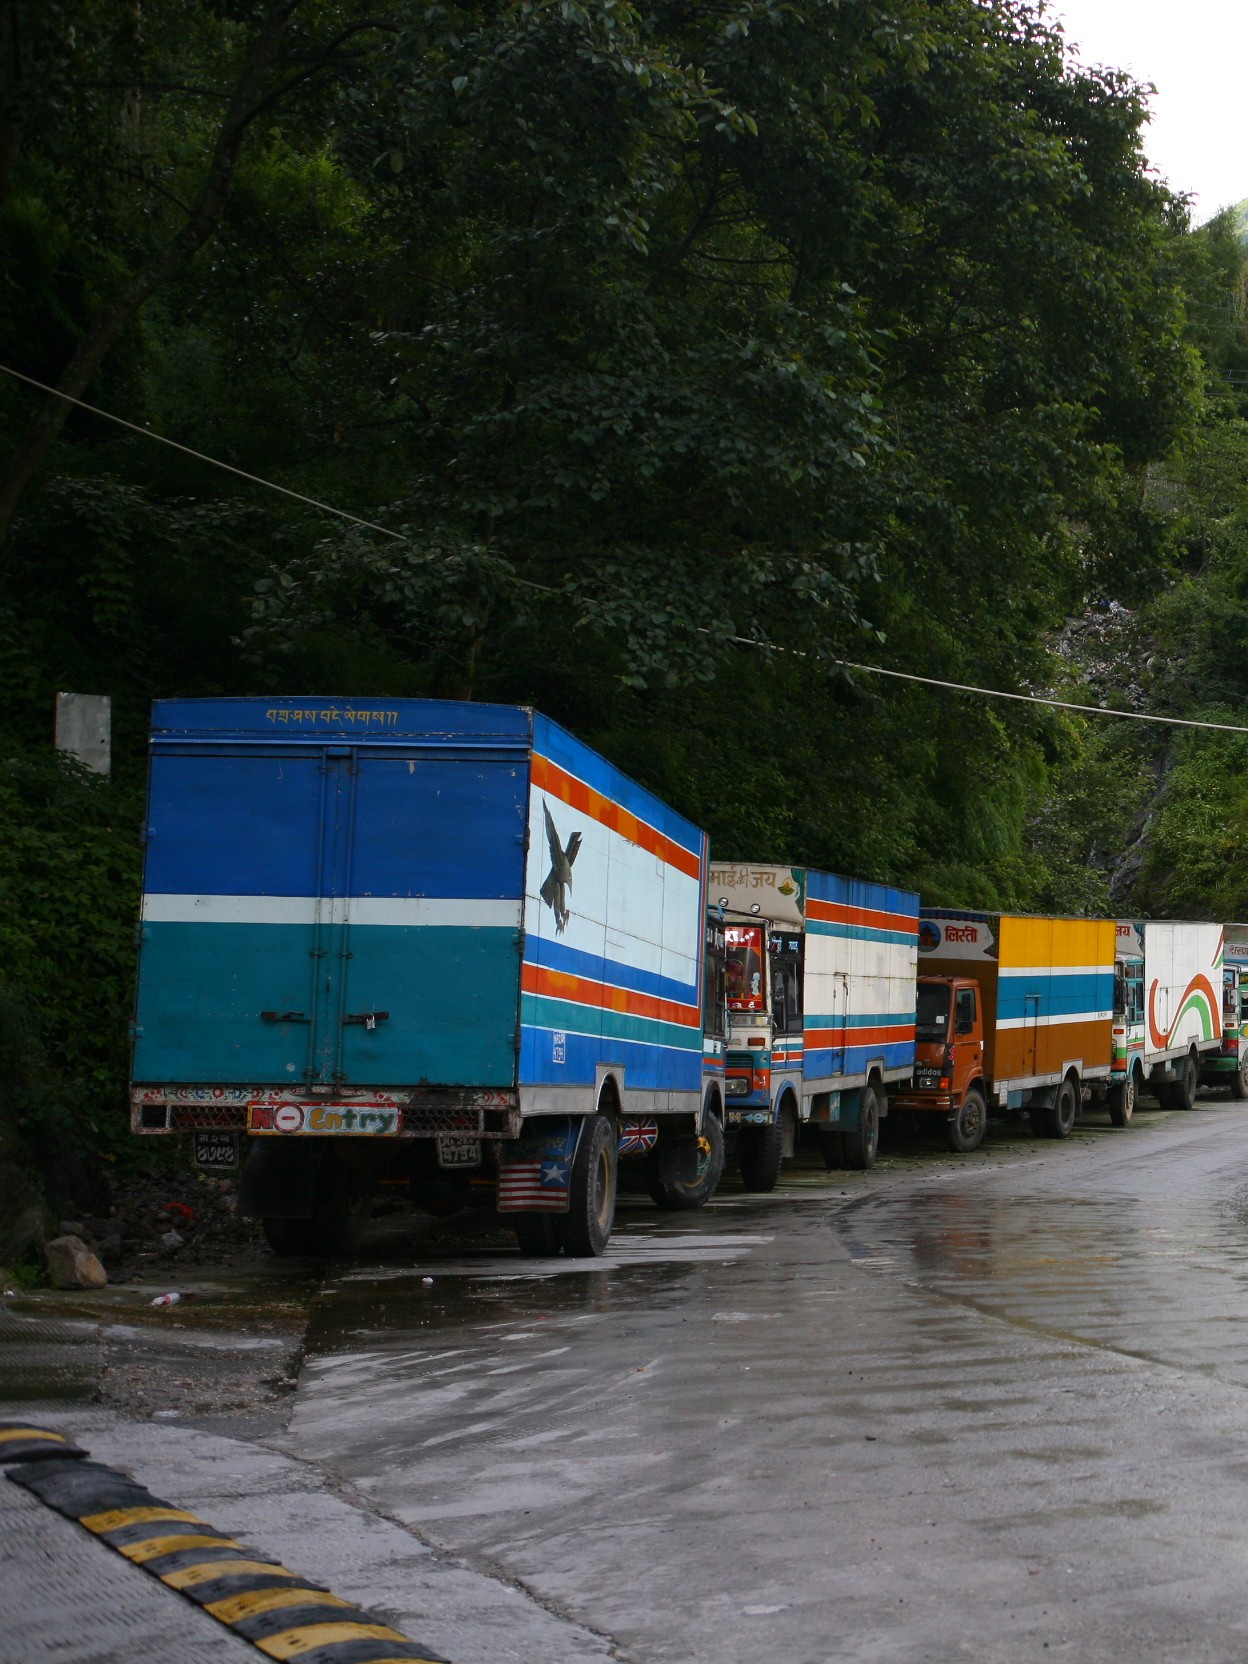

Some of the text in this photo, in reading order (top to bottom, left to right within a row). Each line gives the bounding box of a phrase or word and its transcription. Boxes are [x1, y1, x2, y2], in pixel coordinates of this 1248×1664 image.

[749, 871, 776, 888] जय
[309, 1107, 395, 1134] Entry
[442, 1145, 477, 1161] 4794
